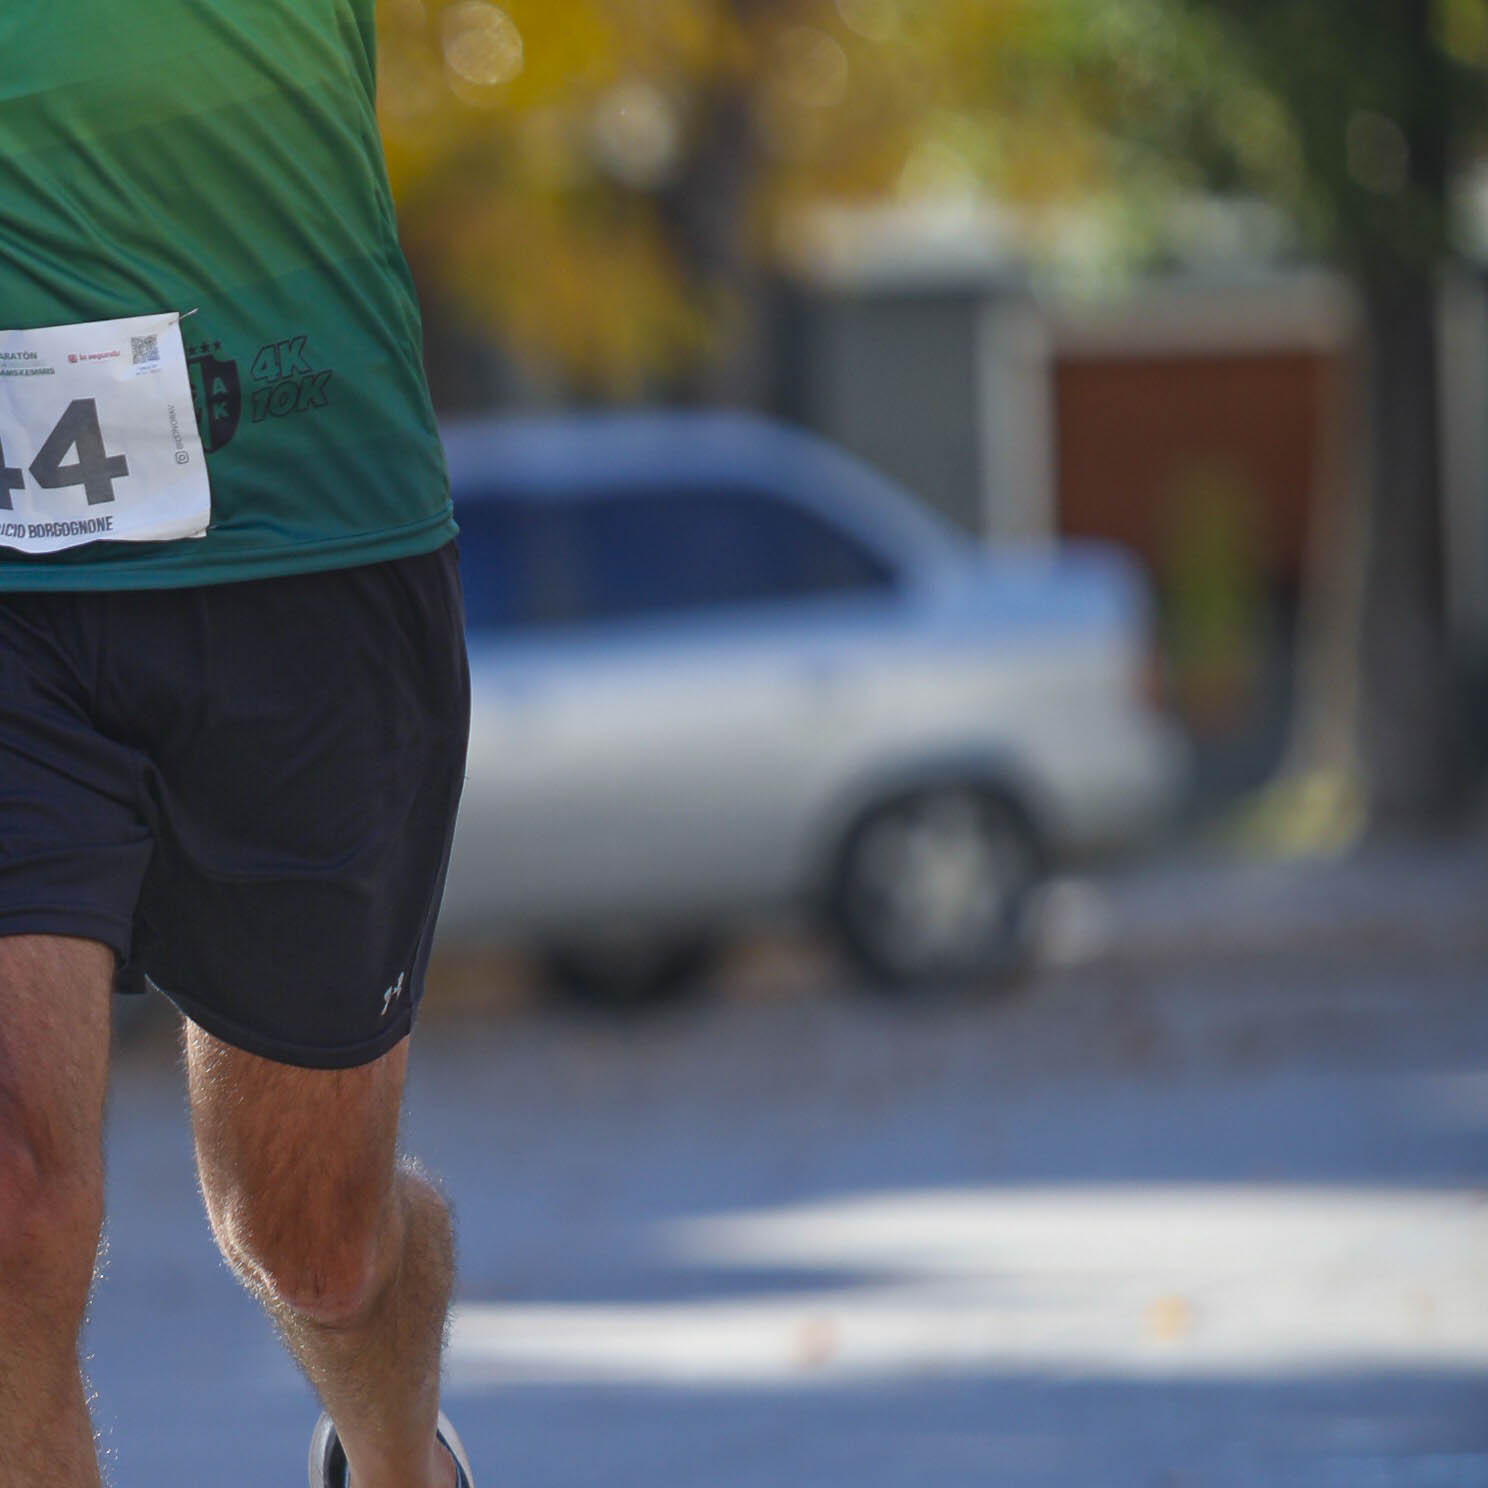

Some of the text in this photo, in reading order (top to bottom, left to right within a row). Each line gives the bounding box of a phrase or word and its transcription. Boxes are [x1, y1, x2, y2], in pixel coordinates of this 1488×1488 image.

[250, 335, 312, 383] 4K
[250, 369, 333, 423] 10K
[28, 515, 114, 539] BORGOGNONE
